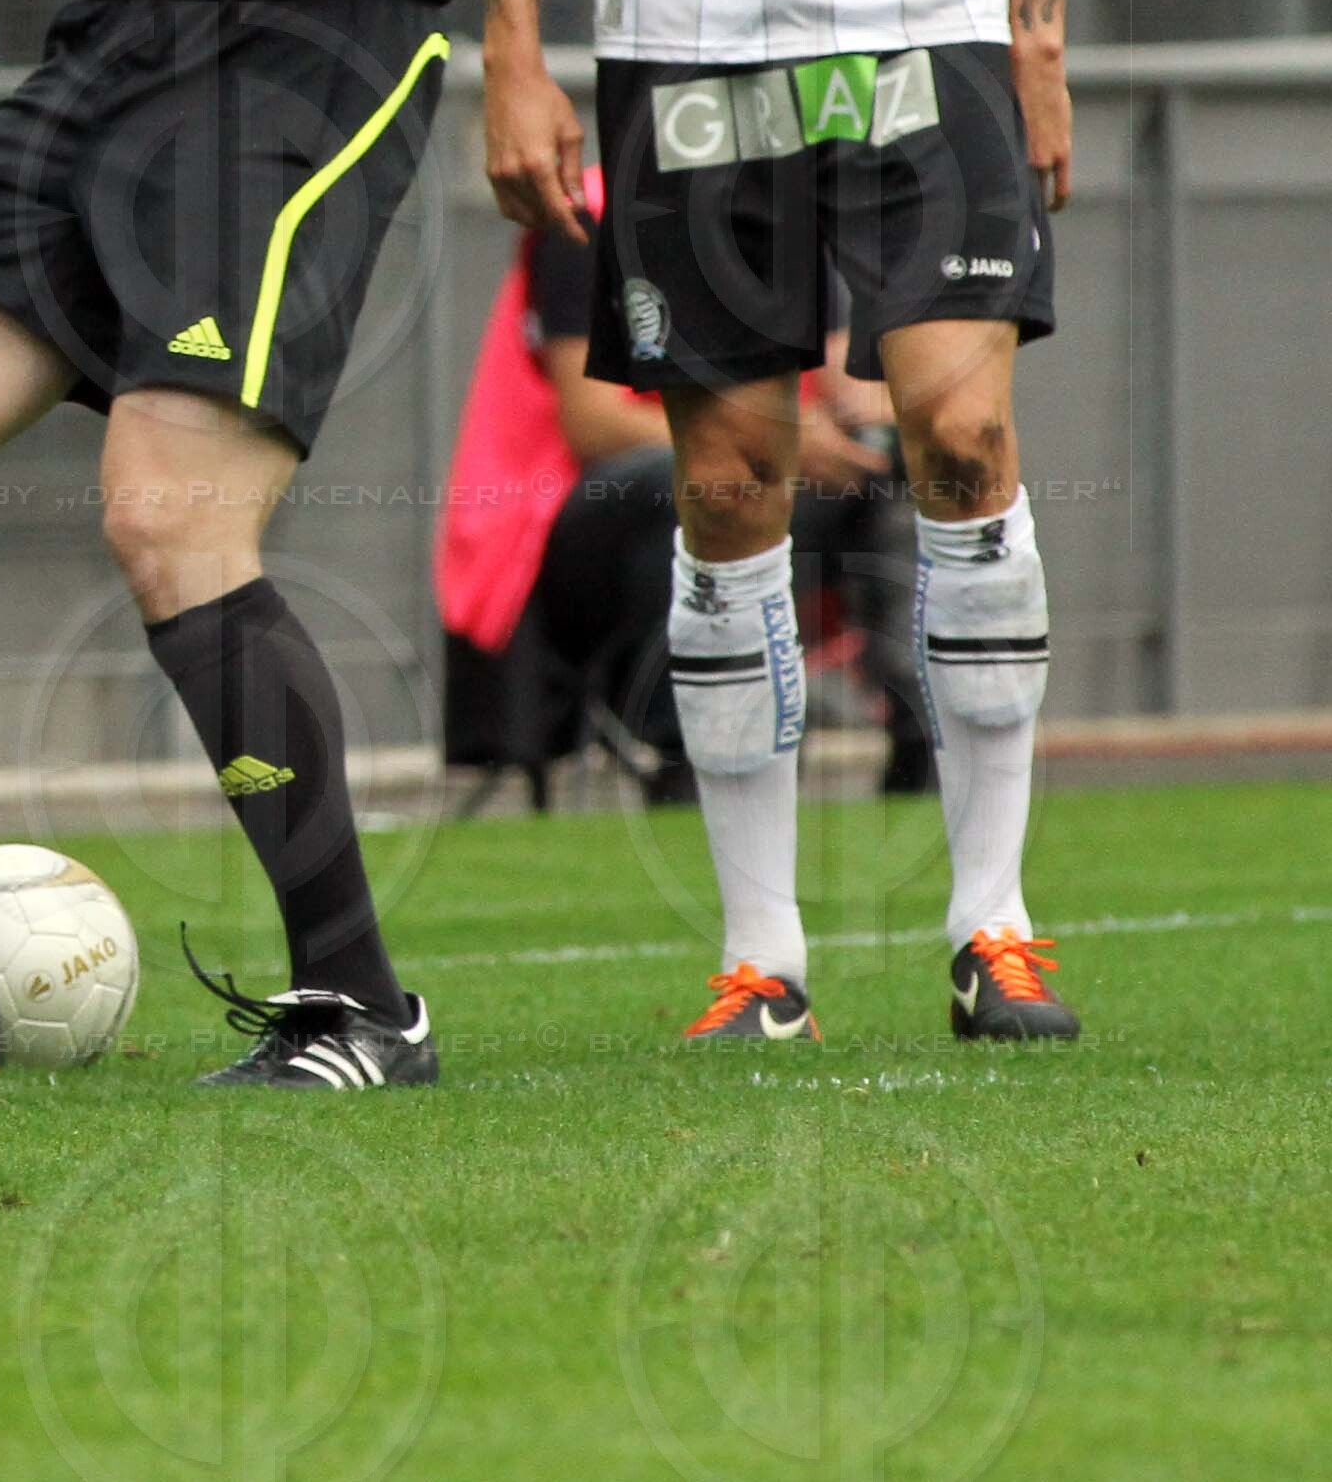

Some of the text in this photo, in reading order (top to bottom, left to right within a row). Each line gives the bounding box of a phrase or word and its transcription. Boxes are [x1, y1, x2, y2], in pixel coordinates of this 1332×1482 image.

[663, 68, 921, 160] GRAZ
[968, 258, 1014, 279] JAKO
[60, 935, 119, 987] JAKO
